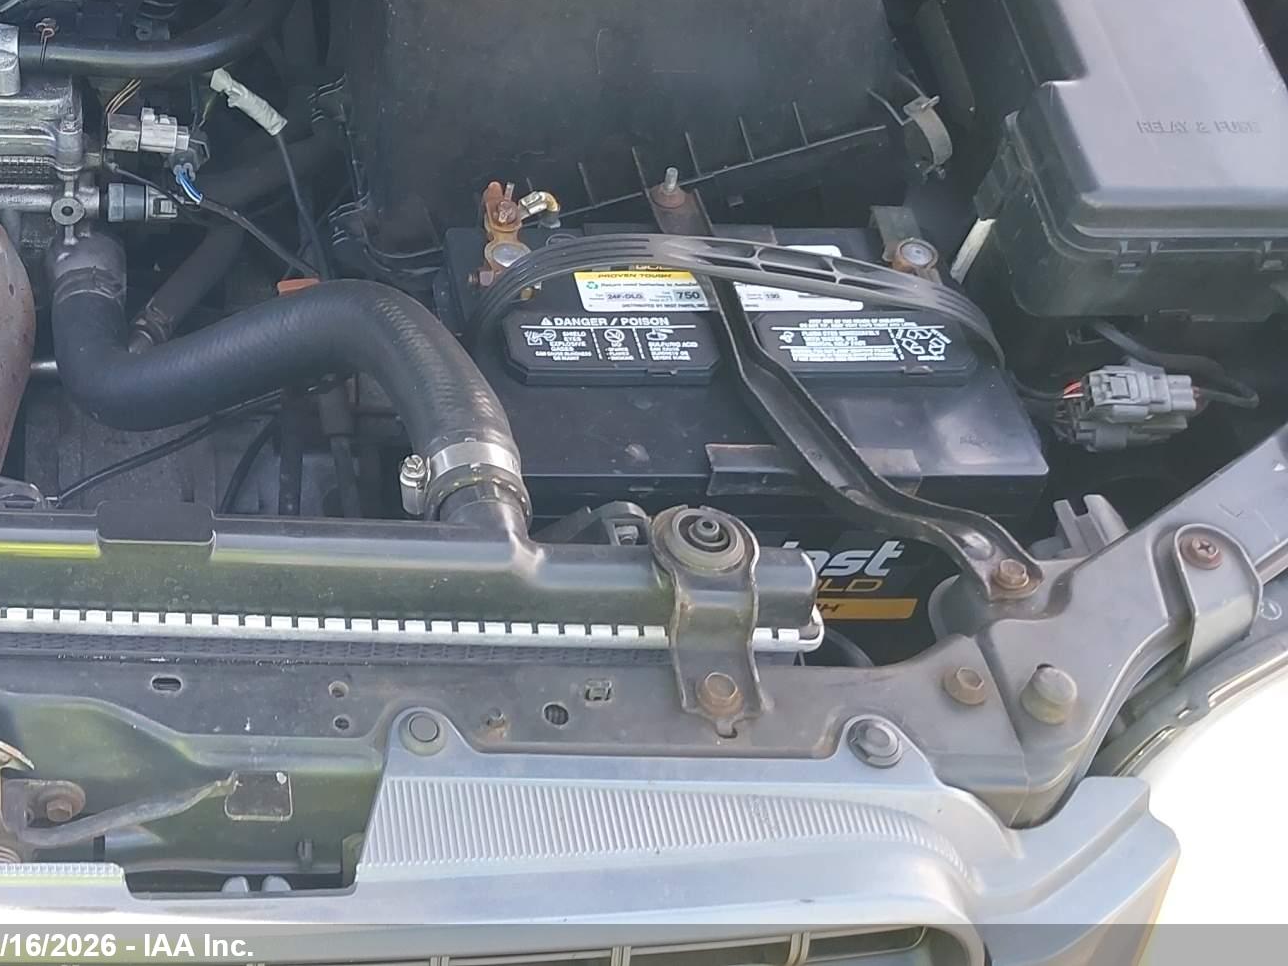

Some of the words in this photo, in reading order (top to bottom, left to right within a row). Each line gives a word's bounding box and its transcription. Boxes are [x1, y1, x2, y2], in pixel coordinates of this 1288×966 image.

[676, 291, 700, 300] 750
[553, 317, 608, 326] DANGER
[620, 317, 671, 326] POISON
[782, 540, 906, 577] ast
[816, 578, 884, 593] LD
